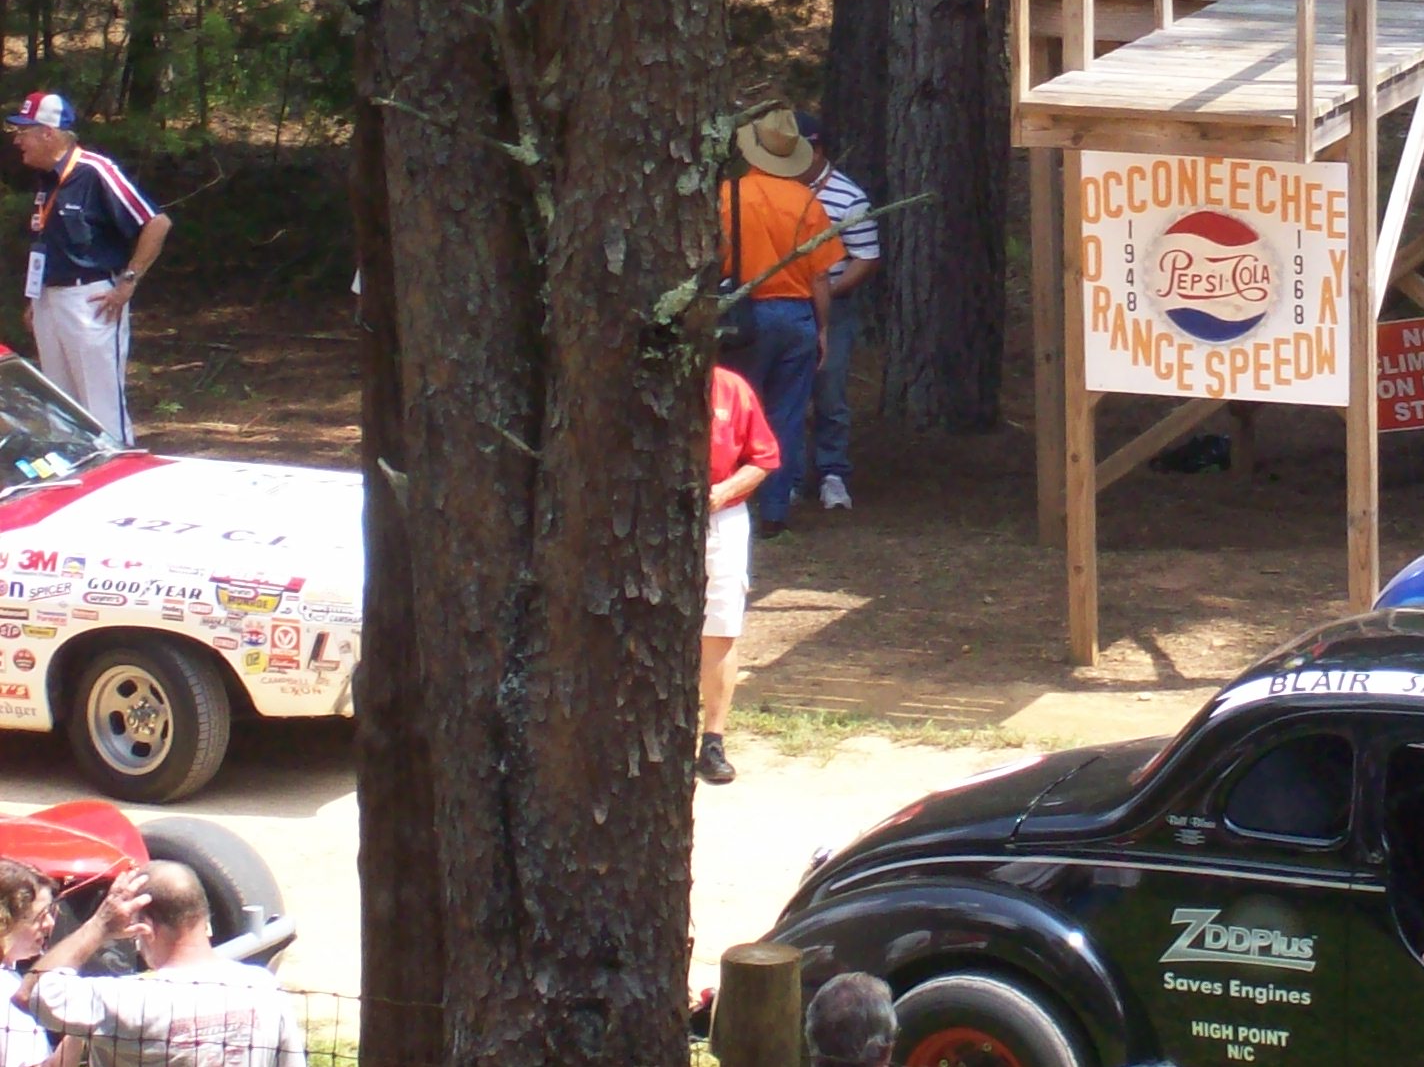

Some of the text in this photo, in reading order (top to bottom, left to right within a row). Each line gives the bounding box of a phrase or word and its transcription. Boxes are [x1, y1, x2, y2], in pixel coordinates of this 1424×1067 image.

[1081, 156, 1347, 239] OCCONEECHEE
[1082, 235, 1347, 399] ORANGE SPEEDWAY
[1377, 377, 1415, 399] ON
[106, 516, 203, 534] 427
[18, 549, 59, 573] 3M
[29, 582, 73, 599] SPICER
[1268, 673, 1370, 696] BLAIR
[1163, 971, 1312, 1005] Saves Engines
[1191, 1020, 1290, 1047] HIGH POINT
